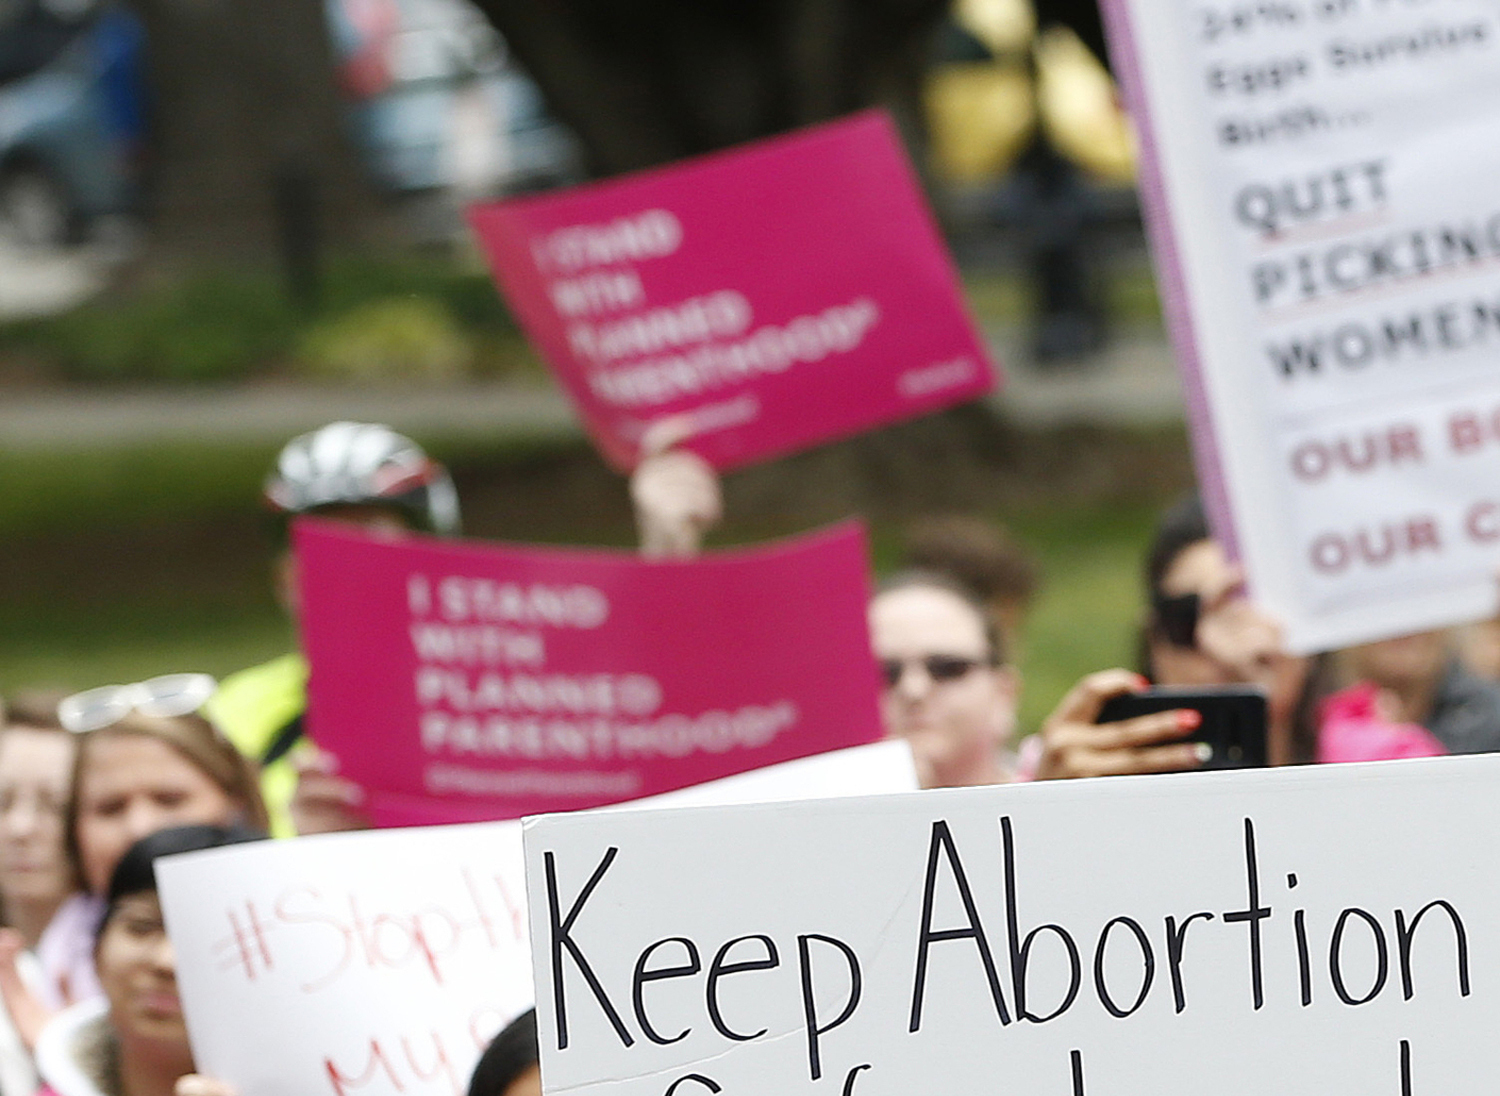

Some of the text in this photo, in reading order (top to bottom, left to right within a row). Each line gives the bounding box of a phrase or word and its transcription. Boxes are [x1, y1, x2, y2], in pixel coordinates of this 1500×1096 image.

[1233, 156, 1389, 236] QUIT
[1290, 423, 1424, 484] OUR
[1309, 512, 1443, 576] OUR
[438, 576, 609, 629] STAND
[410, 624, 546, 666] WITH
[415, 666, 663, 715] PLANNED
[543, 815, 1471, 1080] Keep Abortion
